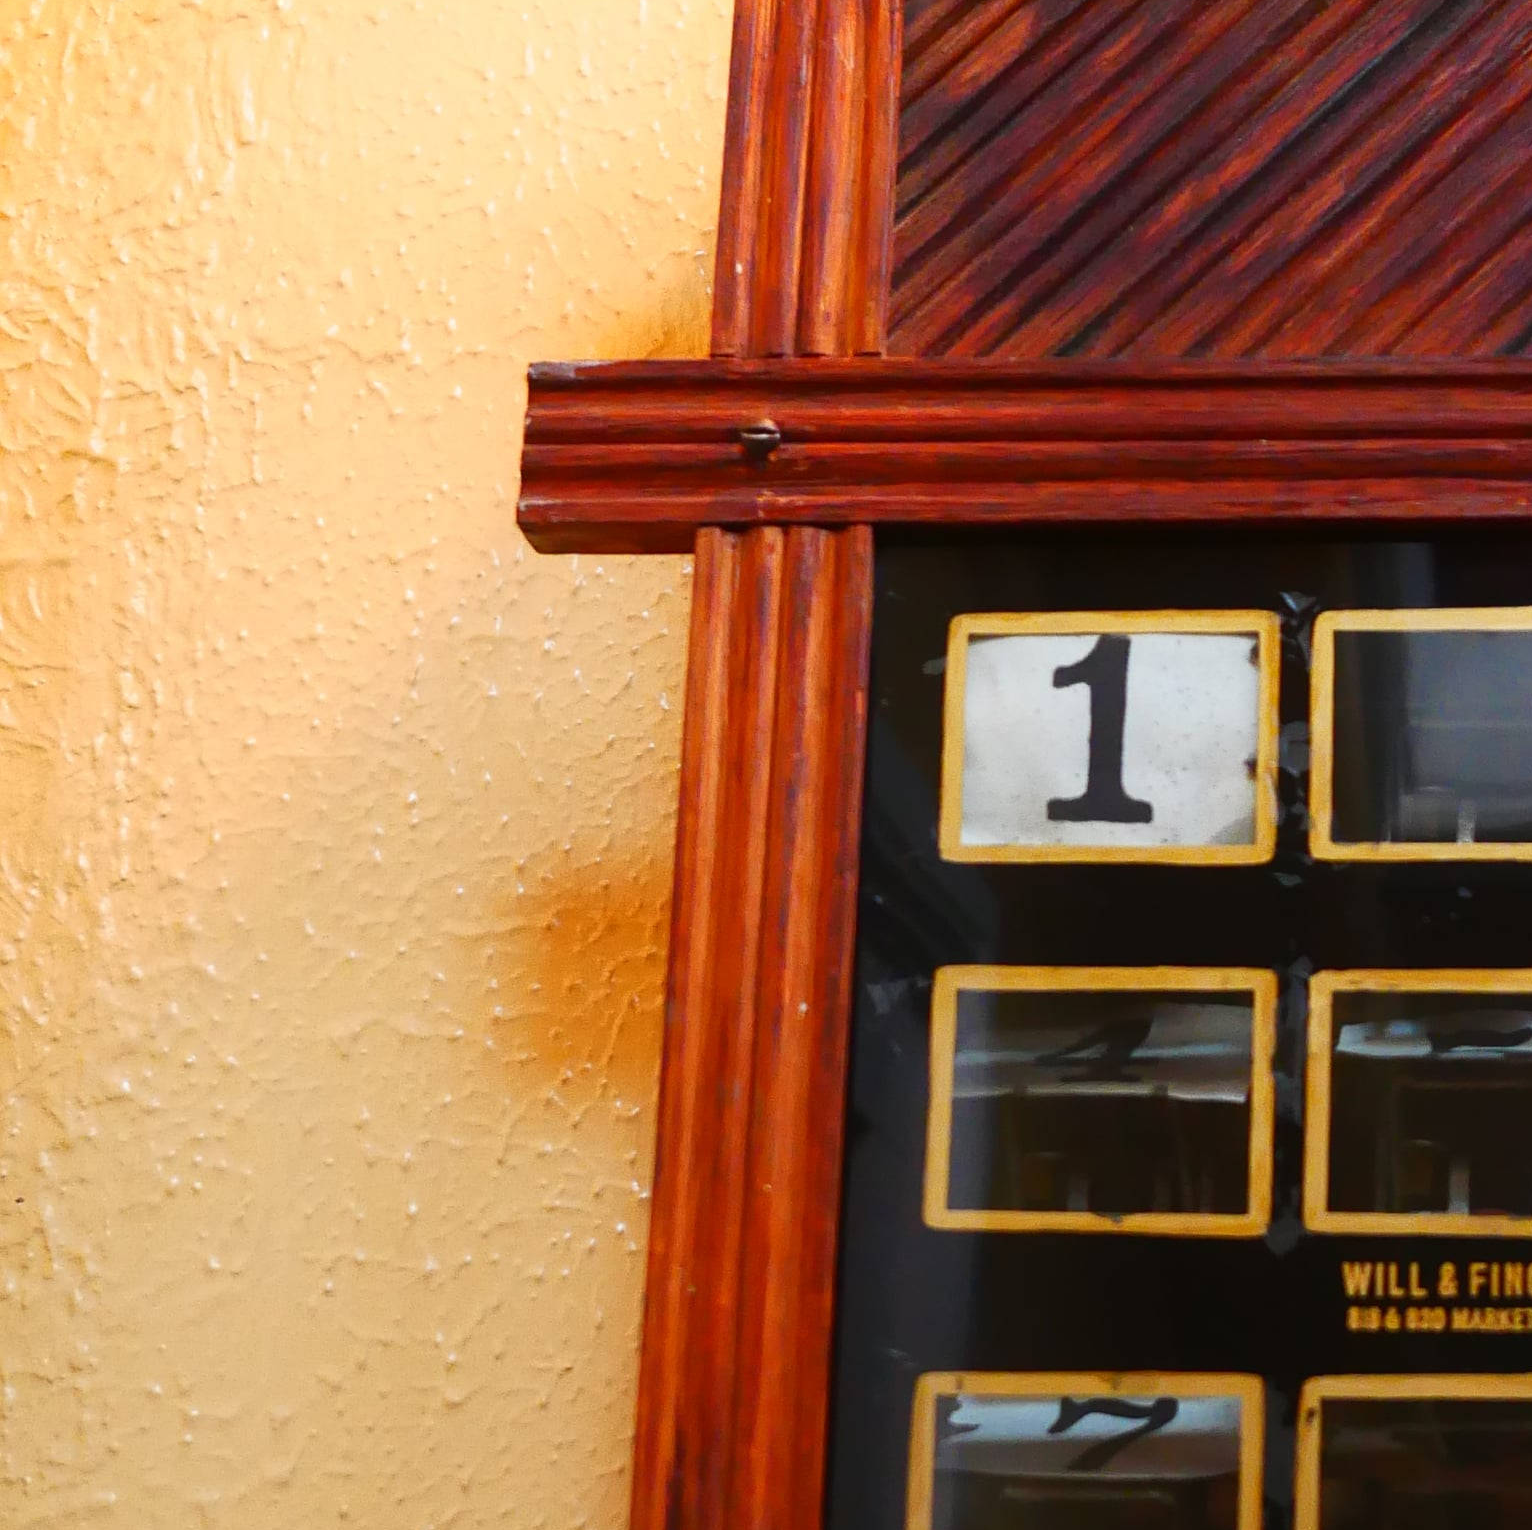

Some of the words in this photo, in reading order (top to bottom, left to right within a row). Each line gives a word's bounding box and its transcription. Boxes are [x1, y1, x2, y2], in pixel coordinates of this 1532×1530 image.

[1047, 636, 1152, 823] 1
[1342, 1262, 1427, 1298] WILL
[1438, 1262, 1458, 1297] &
[1048, 1395, 1178, 1471] 7
